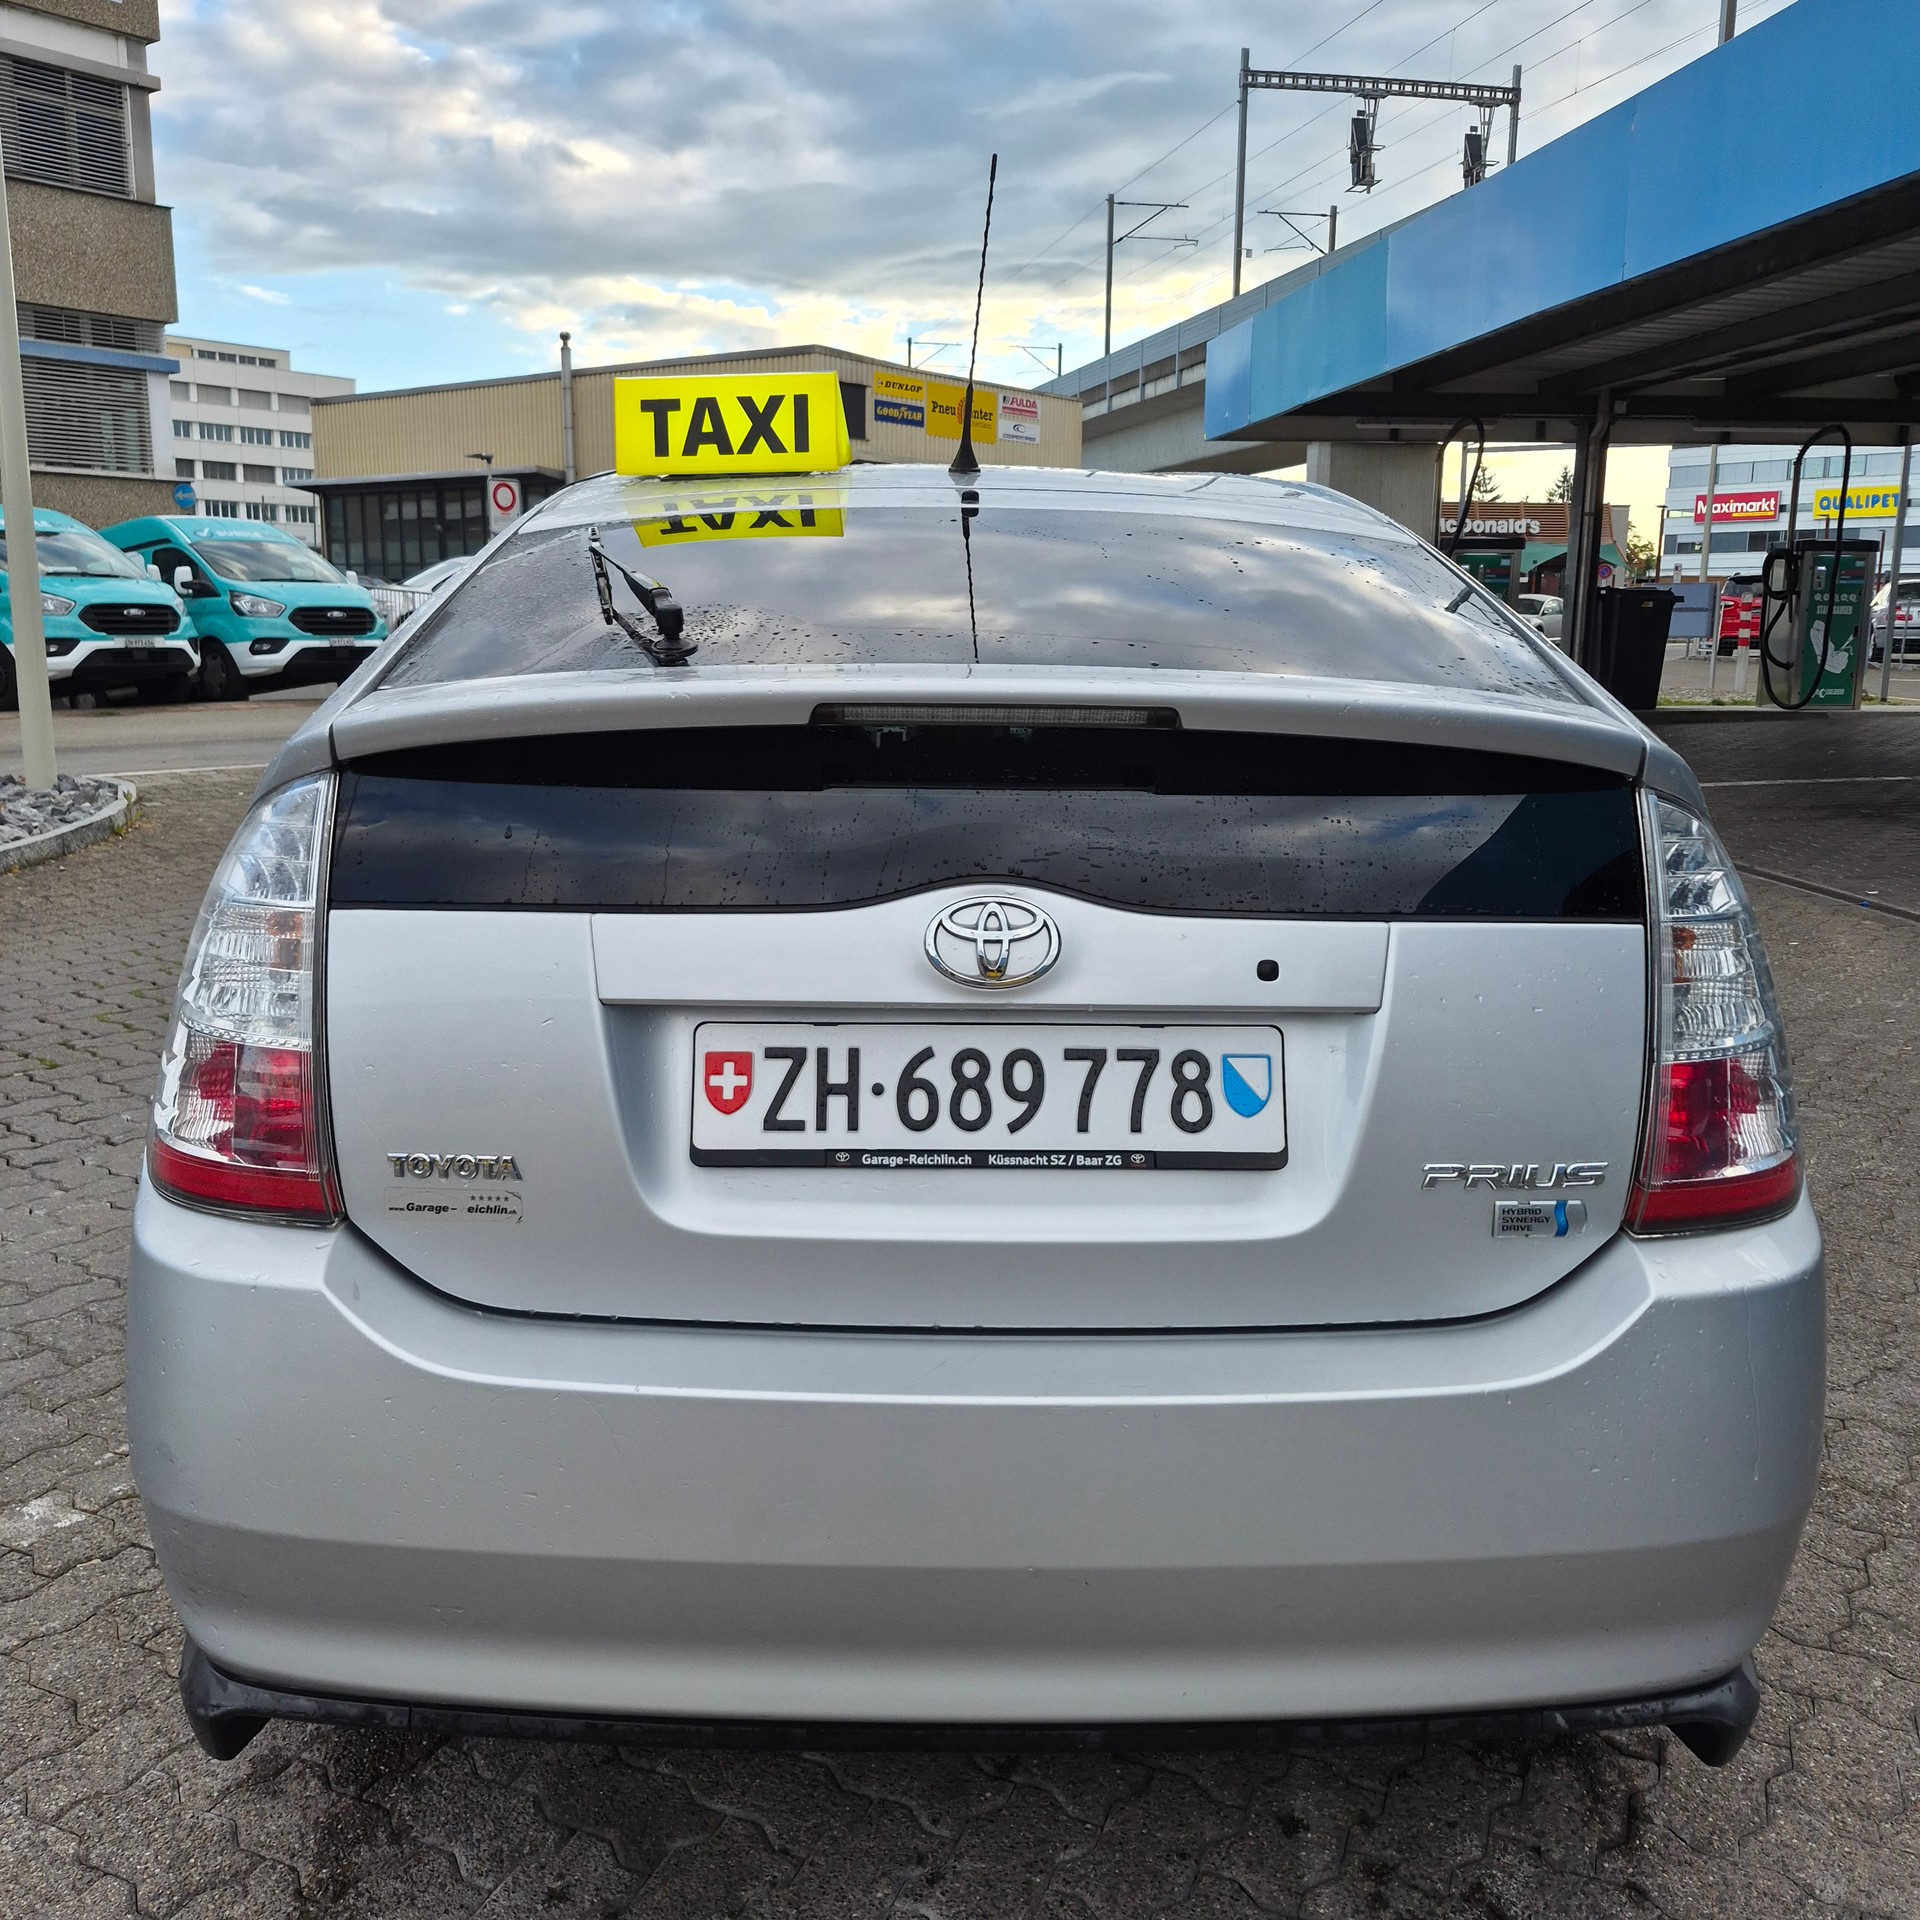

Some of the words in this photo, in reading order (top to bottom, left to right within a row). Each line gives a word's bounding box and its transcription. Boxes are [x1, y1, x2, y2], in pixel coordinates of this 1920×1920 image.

[884, 381, 923, 393] DUNLOP
[931, 400, 956, 416] Pneu
[1009, 397, 1038, 410] FULDA
[640, 393, 810, 457] TAXI
[1697, 497, 1776, 514] Maximarkt
[1819, 493, 1900, 511] QUALIPET
[387, 1152, 523, 1181] TOYOTA
[861, 1153, 972, 1167] Garage-Reichlin.ch
[988, 1153, 1049, 1166] Küssnacht
[1050, 1154, 1067, 1166] SZ
[1076, 1154, 1103, 1166] Baar
[1104, 1155, 1122, 1166] ZG
[1421, 1161, 1609, 1190] PRIUS
[1502, 1207, 1542, 1216] HYBRID
[1501, 1216, 1552, 1224] SYNERGY
[1501, 1224, 1534, 1232] DRIVE
